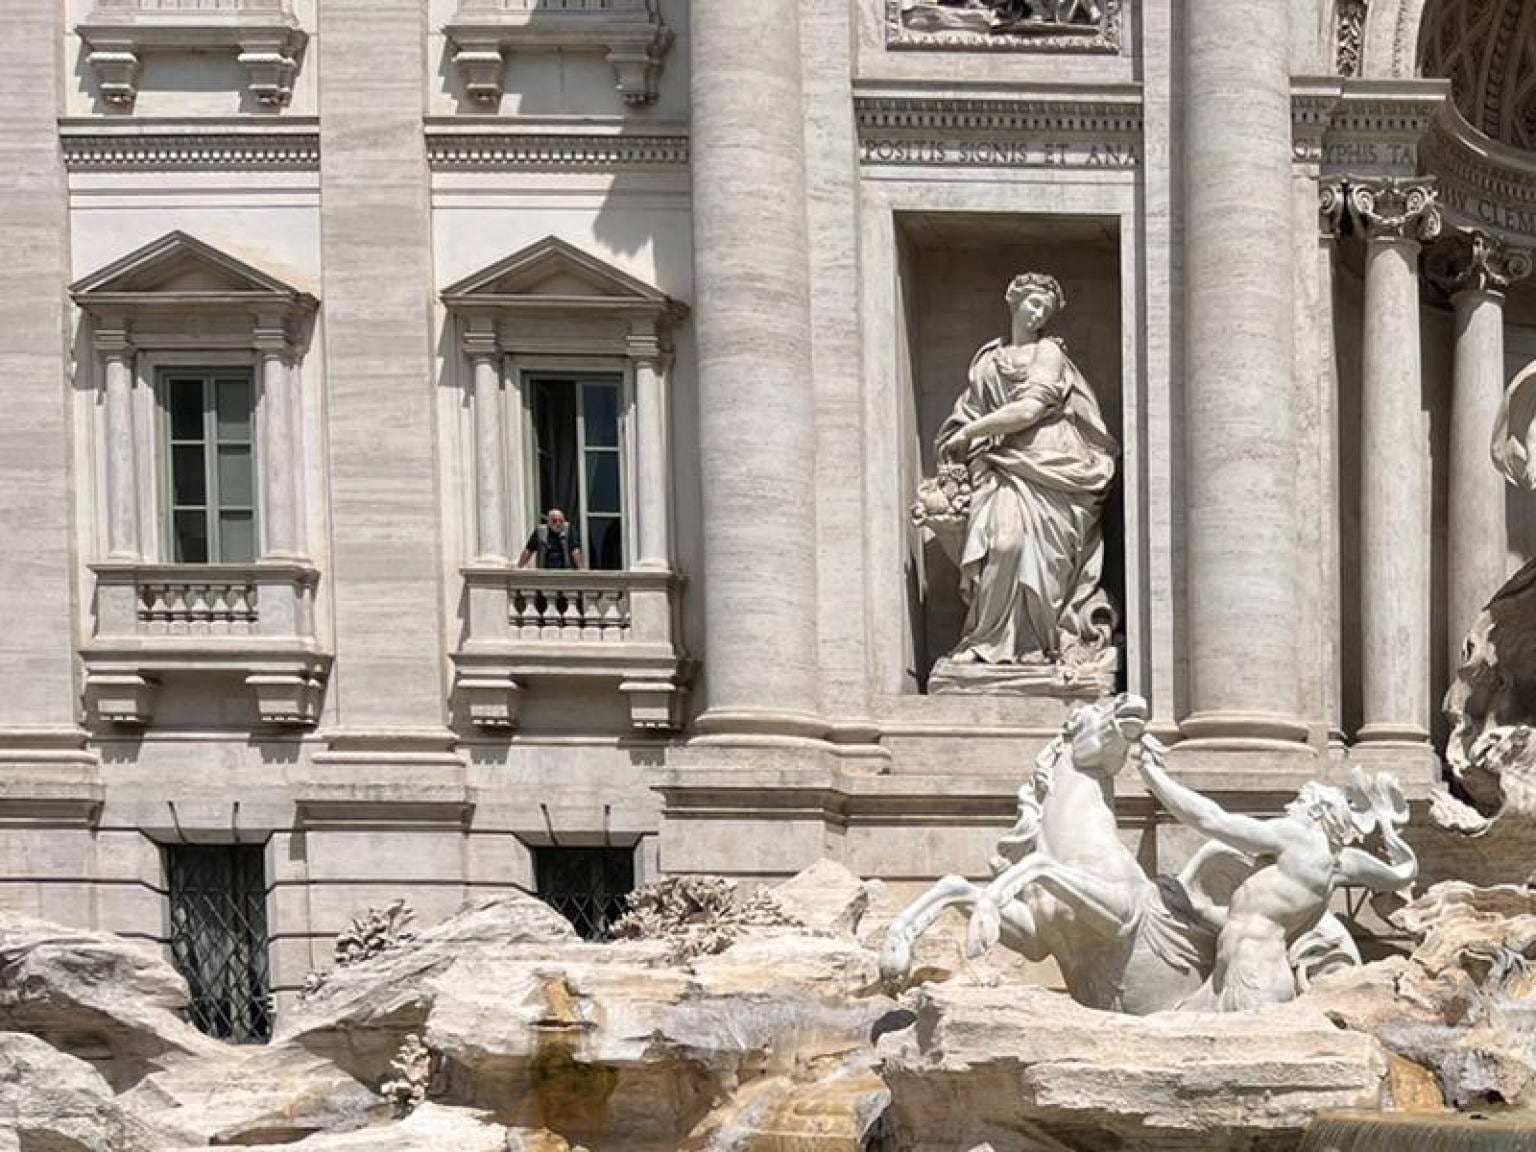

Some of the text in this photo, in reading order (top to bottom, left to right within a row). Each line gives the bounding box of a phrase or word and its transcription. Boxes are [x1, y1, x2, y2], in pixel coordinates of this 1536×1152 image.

[864, 140, 946, 162] POSITIS
[959, 142, 1028, 164] SIGNIS
[1044, 143, 1070, 165] ET
